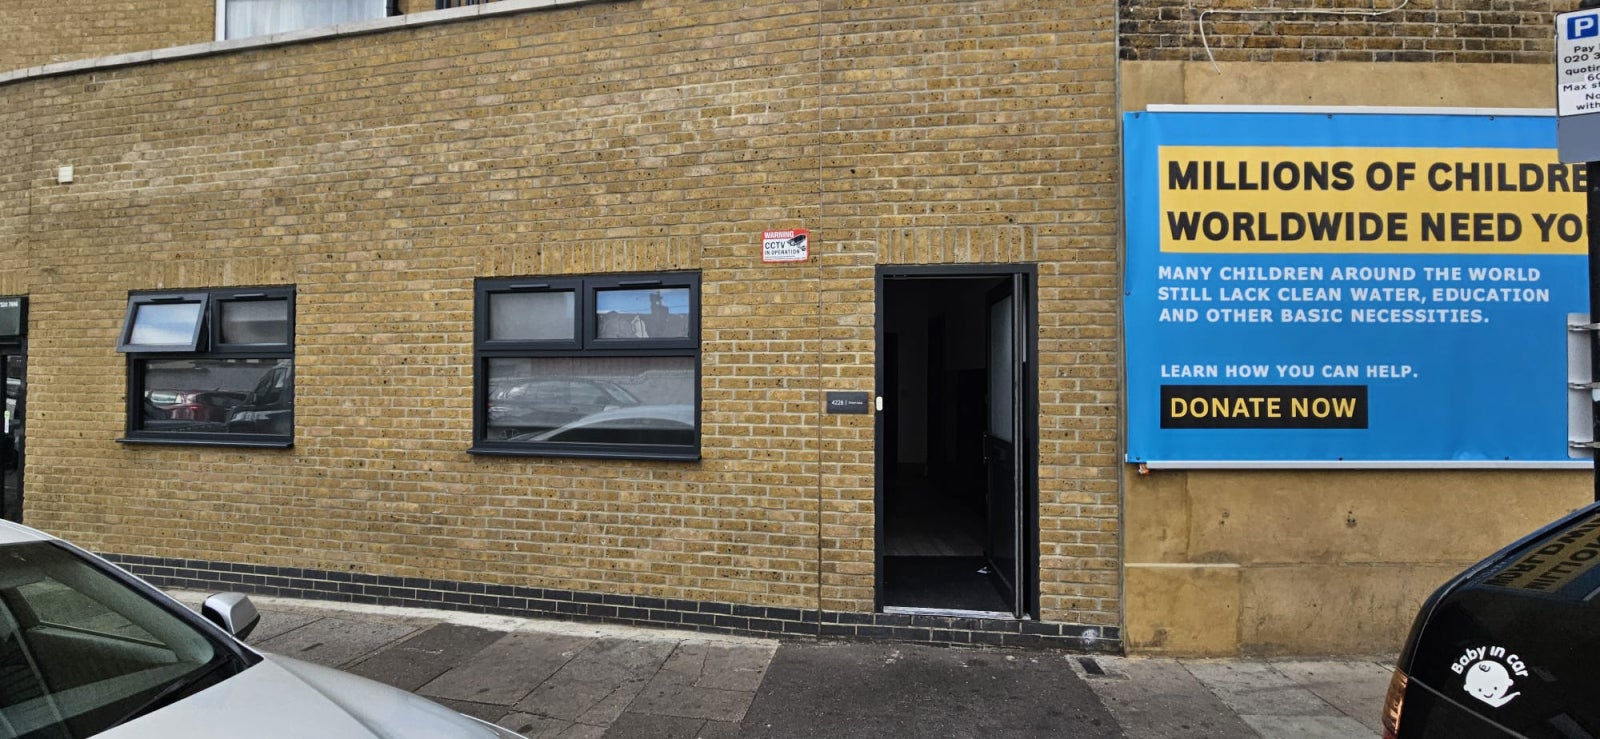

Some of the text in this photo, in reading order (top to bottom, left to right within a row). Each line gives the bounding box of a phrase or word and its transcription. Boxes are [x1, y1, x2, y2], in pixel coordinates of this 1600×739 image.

[1574, 17, 1594, 37] P
[1574, 45, 1594, 53] Pay
[1563, 53, 1589, 63] 020
[1563, 84, 1587, 92] Max
[1168, 160, 1588, 192] MILLIONS OF CHILDRE
[1167, 211, 1589, 242] WORLDWIDE NEED YO
[764, 231, 794, 239] WARNING
[764, 241, 785, 249] CCTV
[1158, 266, 1541, 282] MANY CHILDREN AROUND THE WORLD
[1158, 287, 1550, 304] STILL LACK CLEAN WATER, EDUCATION
[1159, 308, 1490, 323] AND OTHER BASIC NECESSITIES.
[1161, 365, 1419, 378] LEARN HOW YOU CAN HELP.
[1171, 397, 1357, 418] DONATE NOW
[1451, 646, 1486, 675] Baby
[1506, 654, 1529, 677] car
